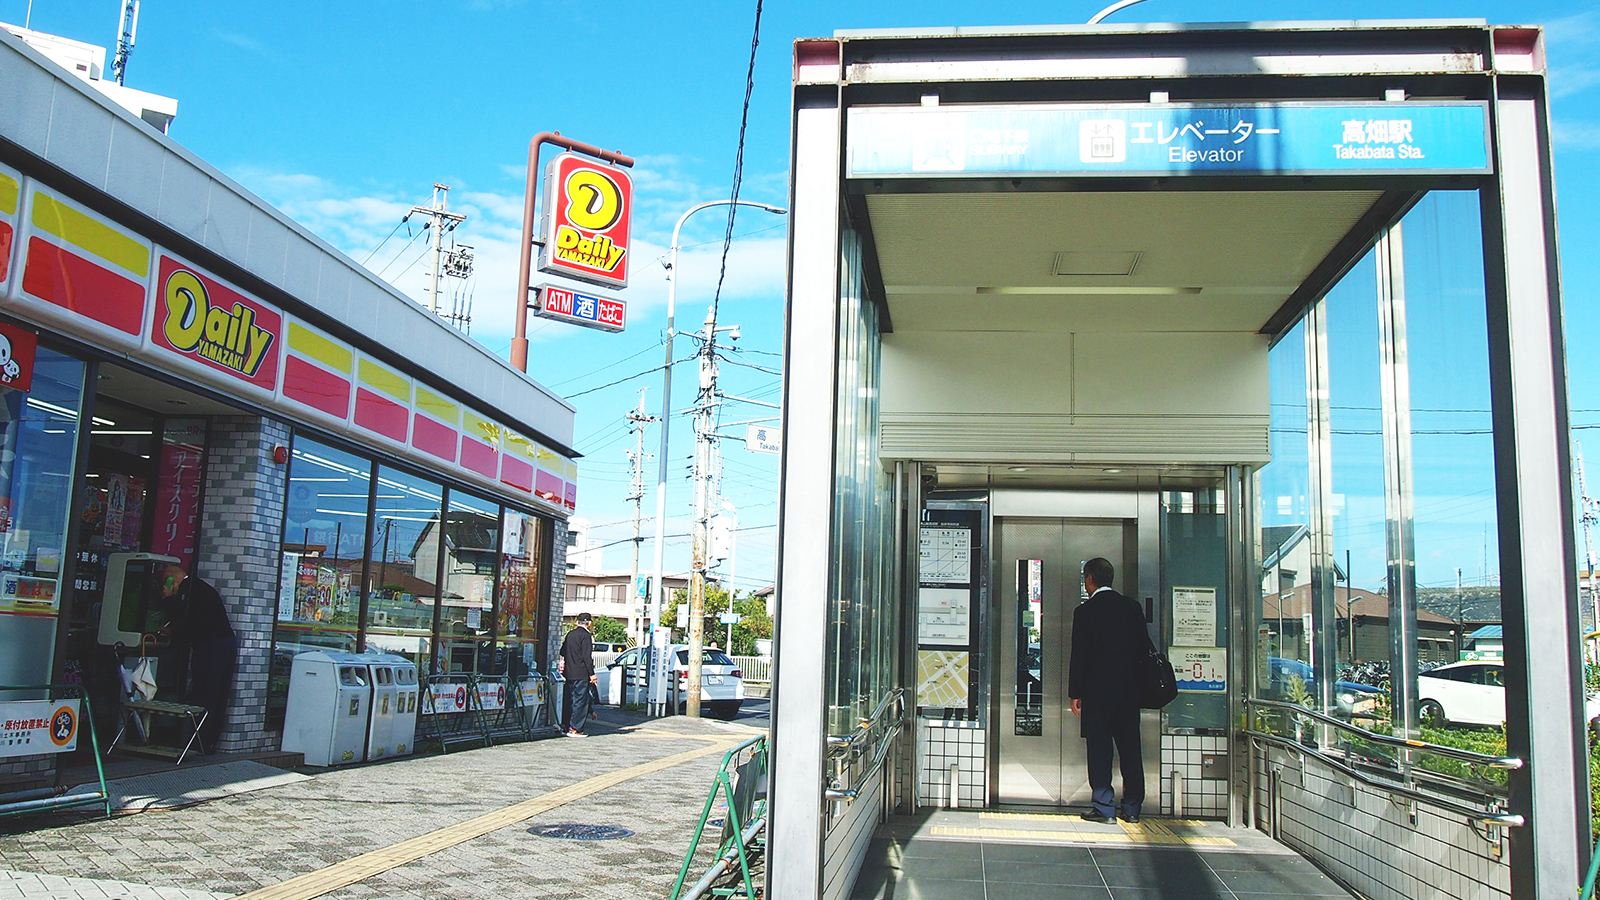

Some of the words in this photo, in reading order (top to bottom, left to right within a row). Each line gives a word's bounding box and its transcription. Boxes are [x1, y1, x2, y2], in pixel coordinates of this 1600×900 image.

[1130, 119, 1280, 145] エレベーター
[1341, 119, 1414, 144] 高畑駅
[968, 144, 1029, 155] SUBWAY
[1168, 146, 1244, 162] Elevator
[1332, 144, 1395, 159] Takabata
[1398, 144, 1425, 159] Sta.
[556, 226, 626, 270] Daily
[556, 246, 606, 268] YAMAZAKI
[547, 289, 572, 314] ATM
[576, 295, 595, 319] 酒
[598, 300, 623, 324] たばこ
[163, 269, 274, 377] Daily
[197, 338, 245, 372] YAMAZAKI
[164, 450, 187, 556] アイスクリー
[5, 579, 18, 595] 酒
[19, 582, 54, 598] たばこ
